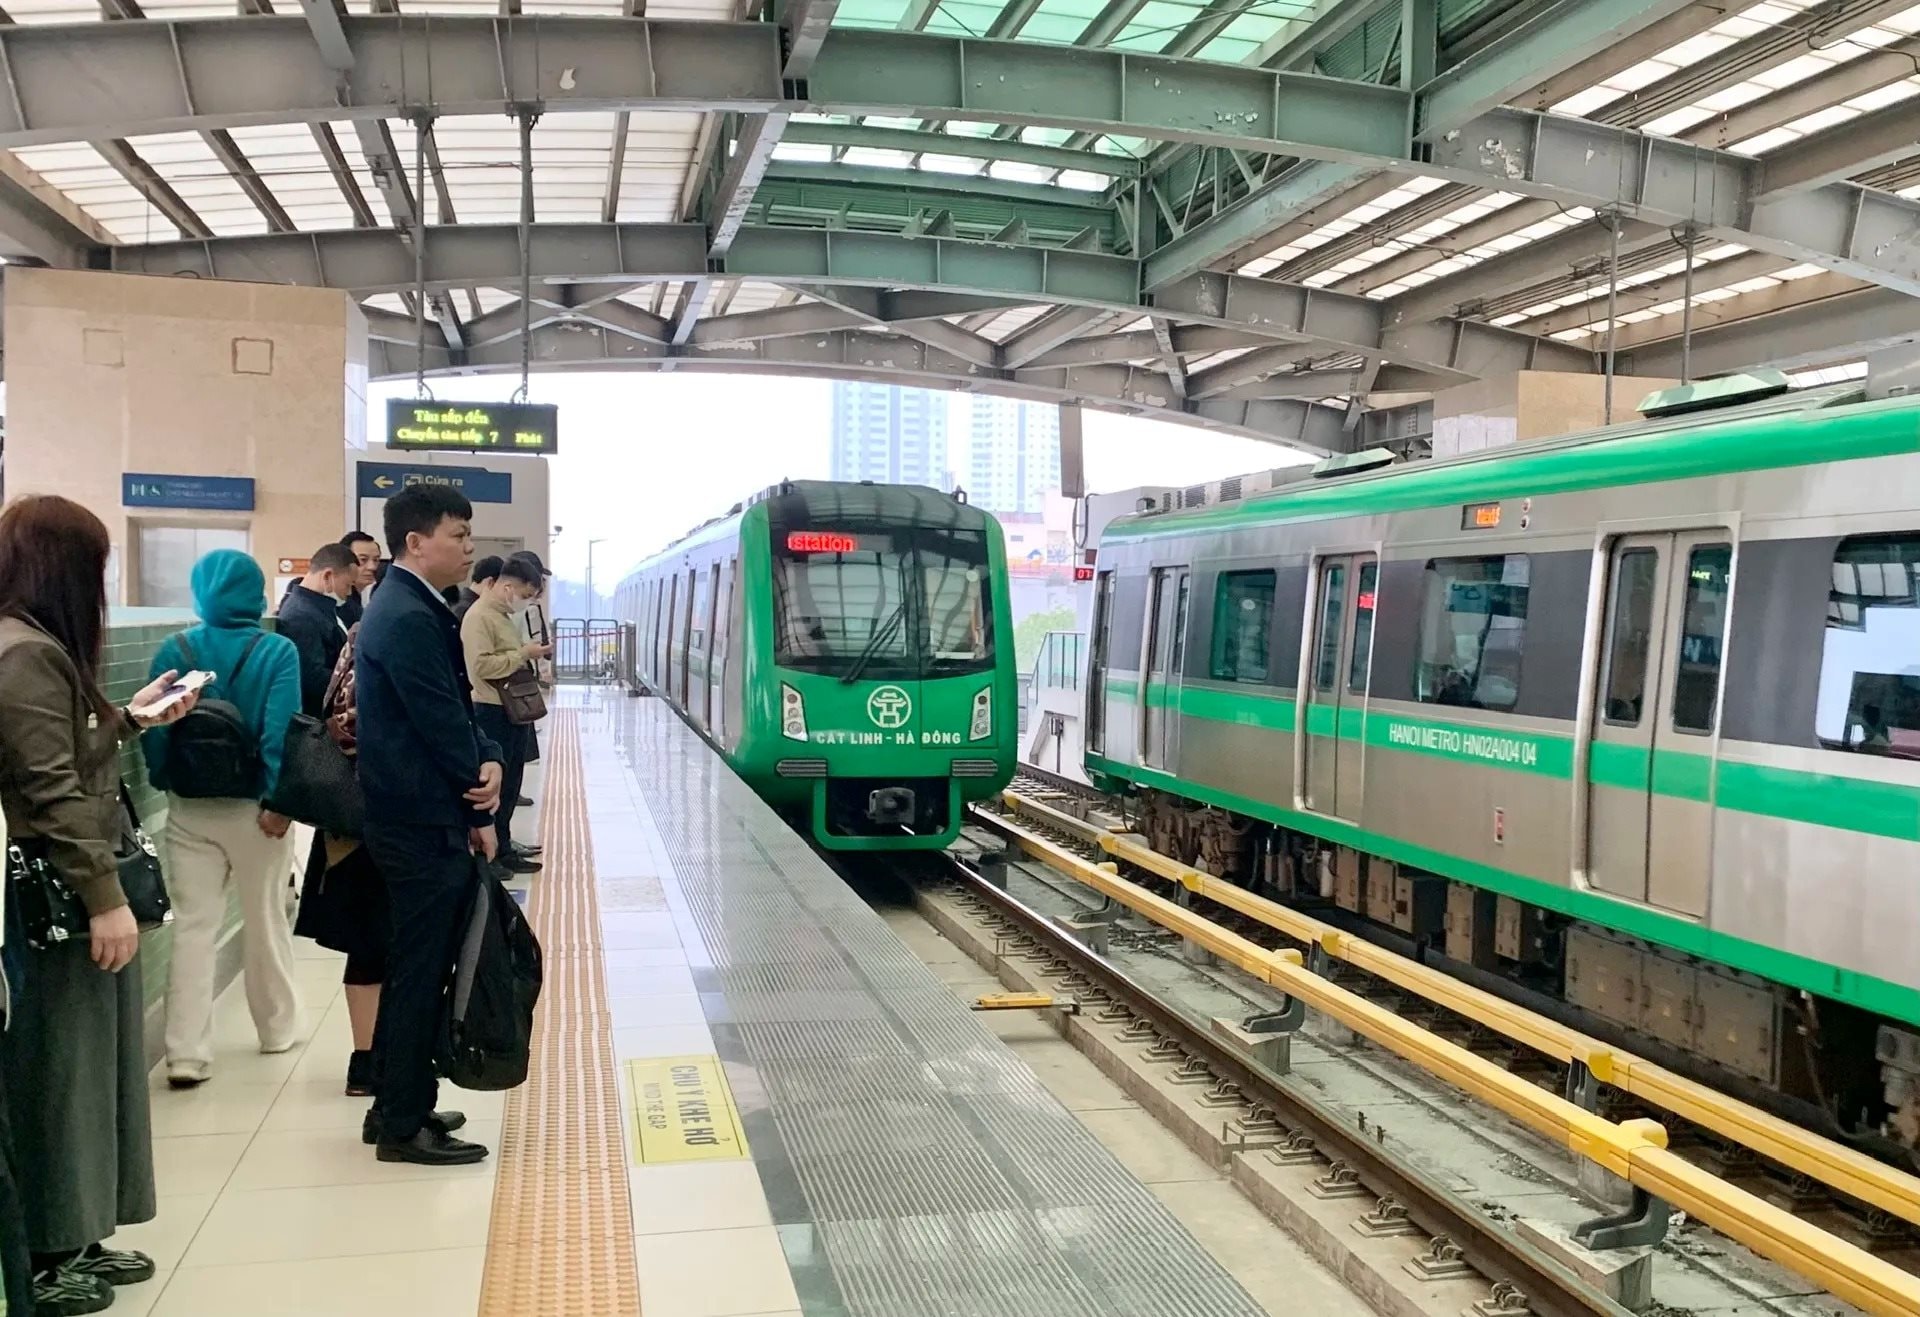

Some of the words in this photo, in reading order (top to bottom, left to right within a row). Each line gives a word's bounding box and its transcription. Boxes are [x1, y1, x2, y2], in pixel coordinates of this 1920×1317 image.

[489, 431, 499, 443] 7
[451, 477, 464, 487] ra
[850, 732, 883, 745] LINH
[895, 730, 915, 745] HÀ
[921, 729, 961, 745] ĐÔNG
[1389, 723, 1421, 746] HANOI
[1421, 728, 1460, 753] METRO
[1521, 741, 1537, 766] 04
[678, 1099, 712, 1125] KHE
[648, 1114, 668, 1130] GAP
